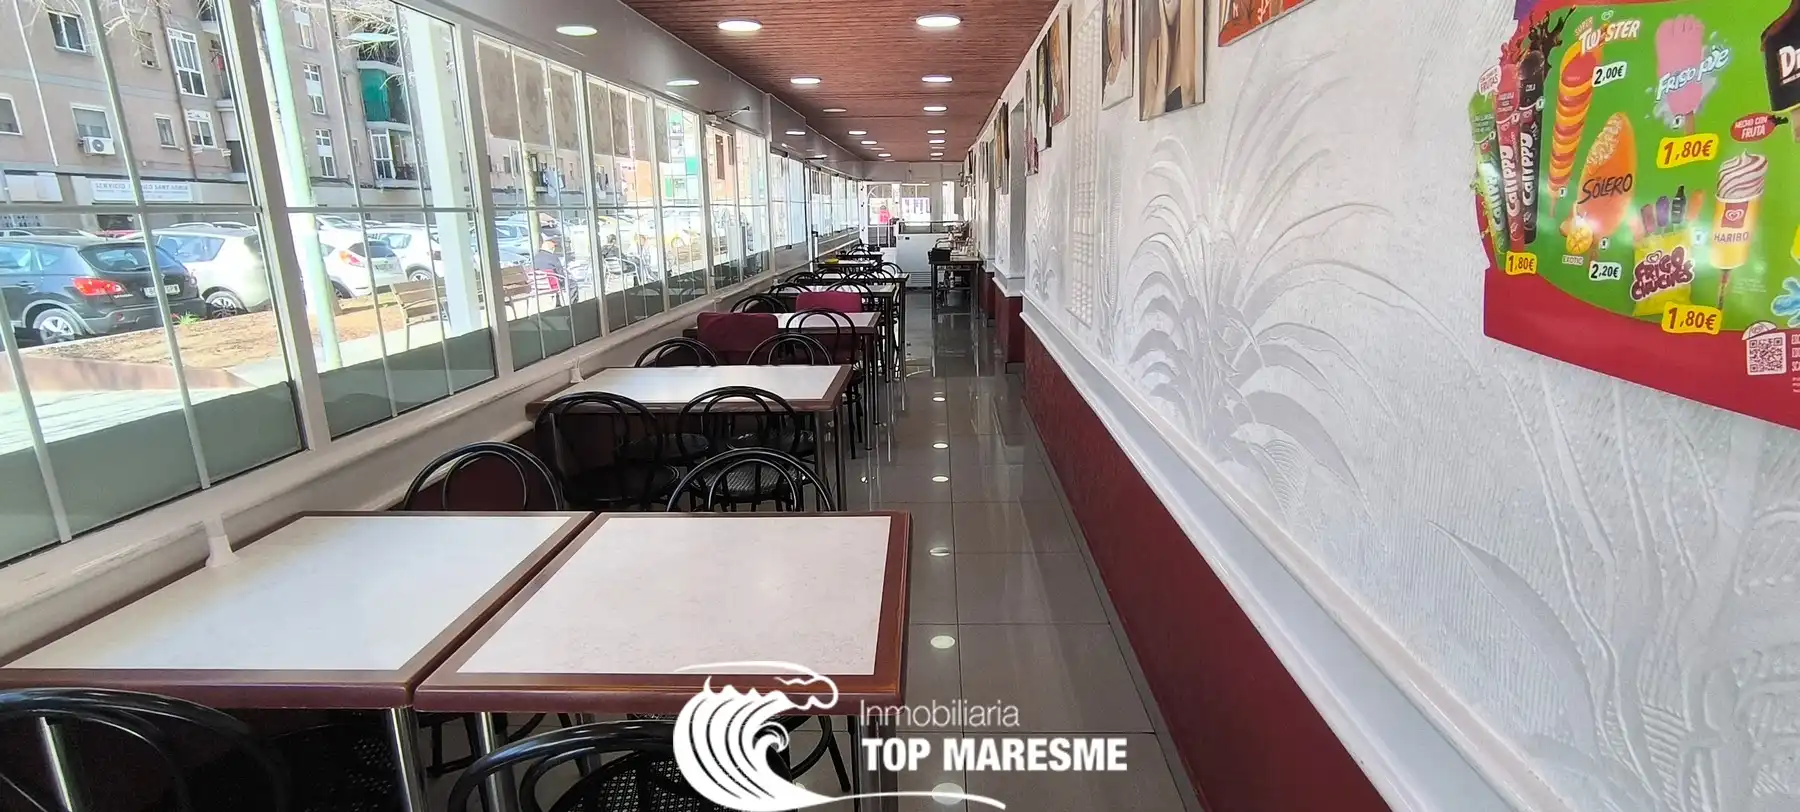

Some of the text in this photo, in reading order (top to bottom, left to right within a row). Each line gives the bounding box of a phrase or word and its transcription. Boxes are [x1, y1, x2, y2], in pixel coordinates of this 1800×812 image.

[1593, 65, 1624, 85] 2,00€
[1741, 124, 1766, 139] FRUTA
[1663, 139, 1714, 165] 1,80€
[1577, 173, 1633, 204] SOLERO
[1713, 231, 1749, 244] HARIBO
[1508, 254, 1535, 273] 1,80€
[1590, 263, 1620, 279] 2,20€
[1668, 306, 1717, 330] 1,80€
